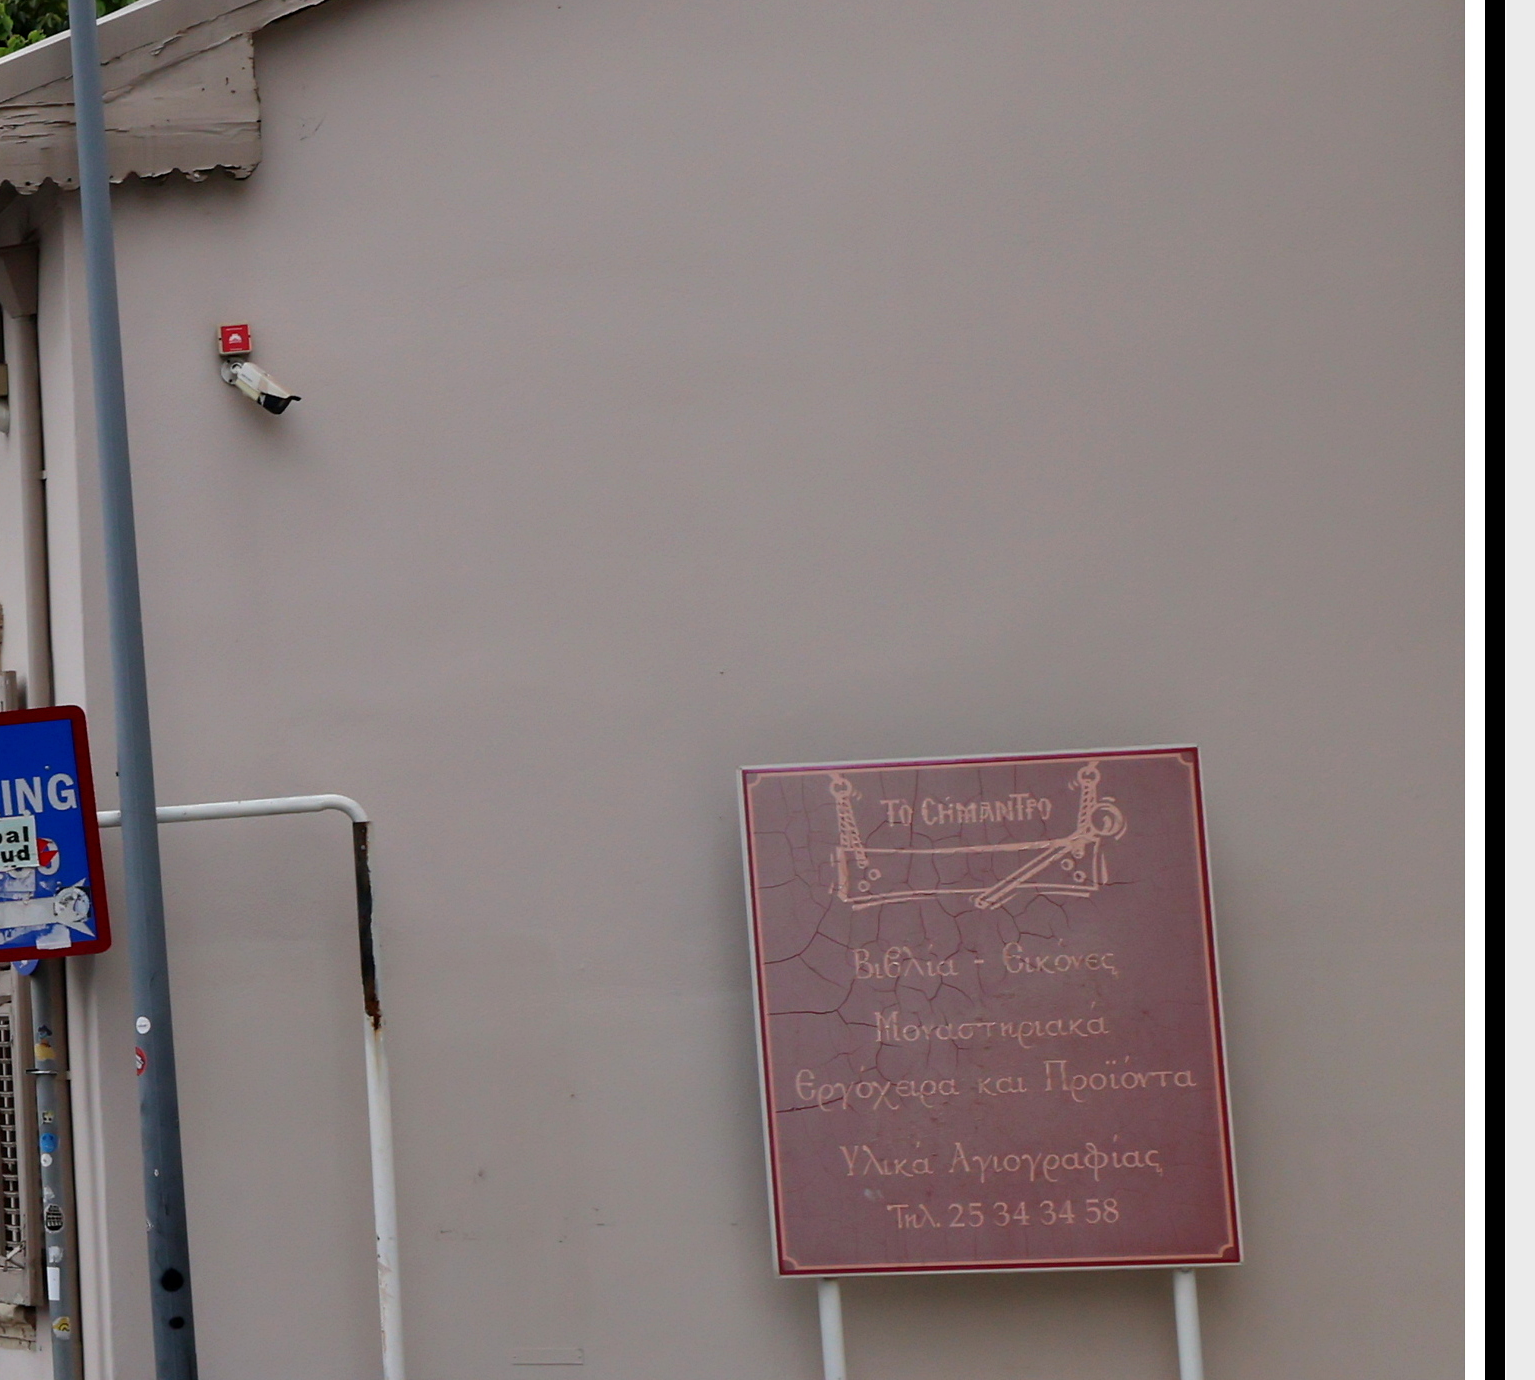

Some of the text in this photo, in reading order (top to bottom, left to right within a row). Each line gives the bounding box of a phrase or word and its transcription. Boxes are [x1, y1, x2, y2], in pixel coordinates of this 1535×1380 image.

[977, 1074, 1027, 1096] και
[949, 1203, 983, 1228] 25
[993, 1202, 1030, 1226] 34
[1040, 1200, 1075, 1224] 34
[1084, 1198, 1120, 1222] 58
